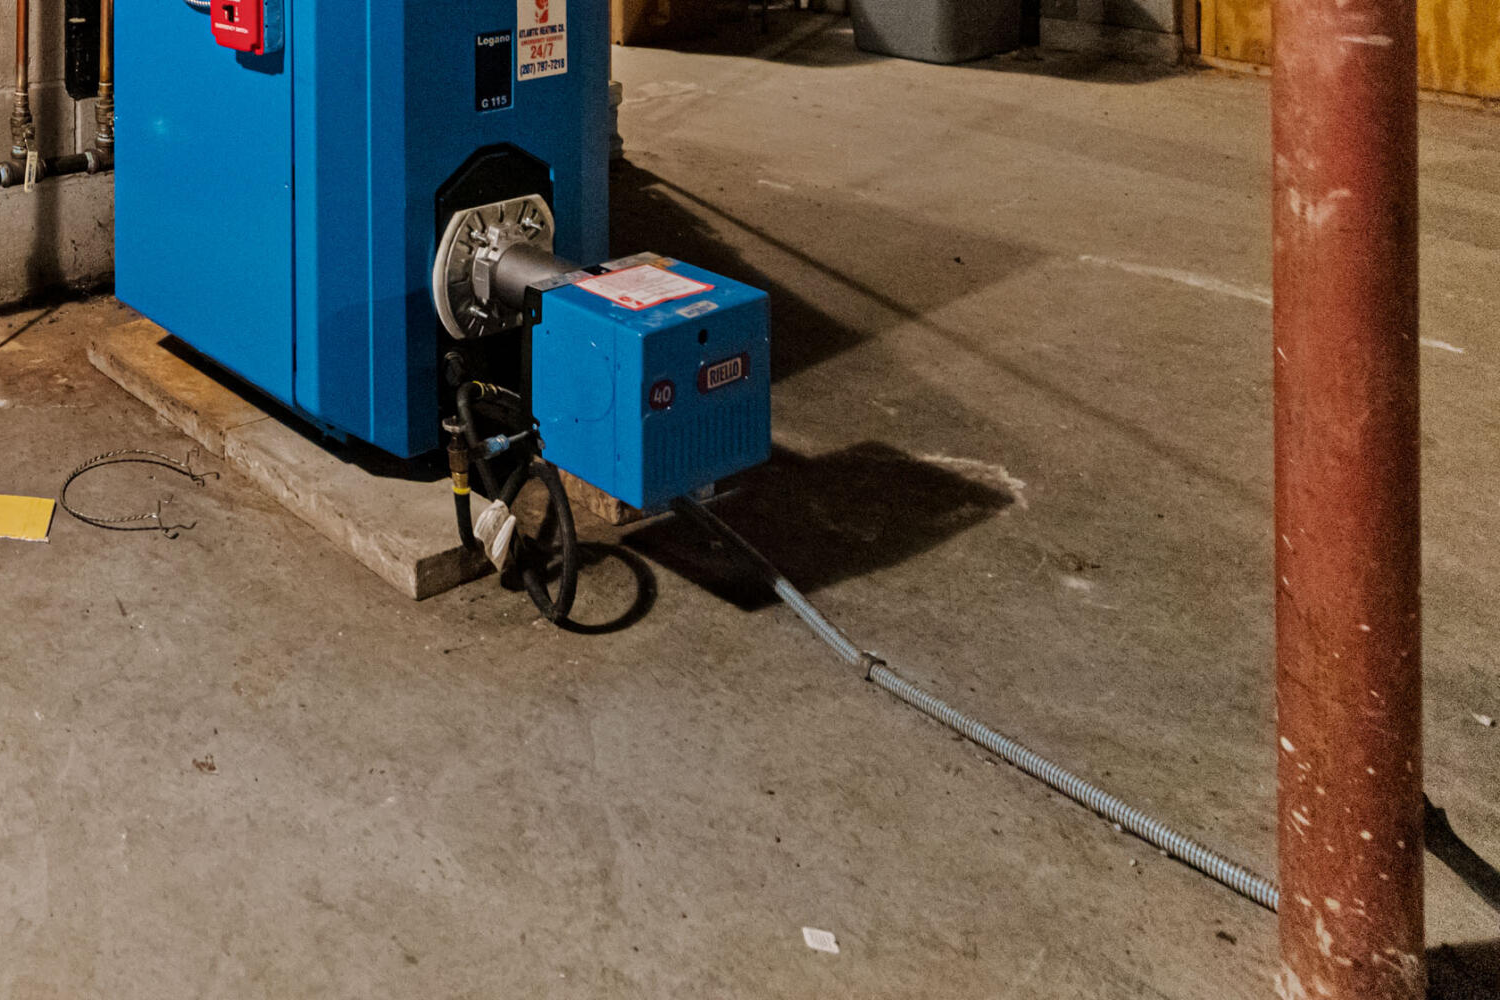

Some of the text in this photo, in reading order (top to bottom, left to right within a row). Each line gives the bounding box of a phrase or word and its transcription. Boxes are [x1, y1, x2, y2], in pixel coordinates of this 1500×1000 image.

[519, 27, 538, 38] ATLANTIC
[477, 34, 510, 47] Logano
[530, 42, 554, 59] 24/7
[481, 95, 507, 108] G 115
[708, 360, 740, 386] RIELLO
[652, 385, 672, 404] 40
